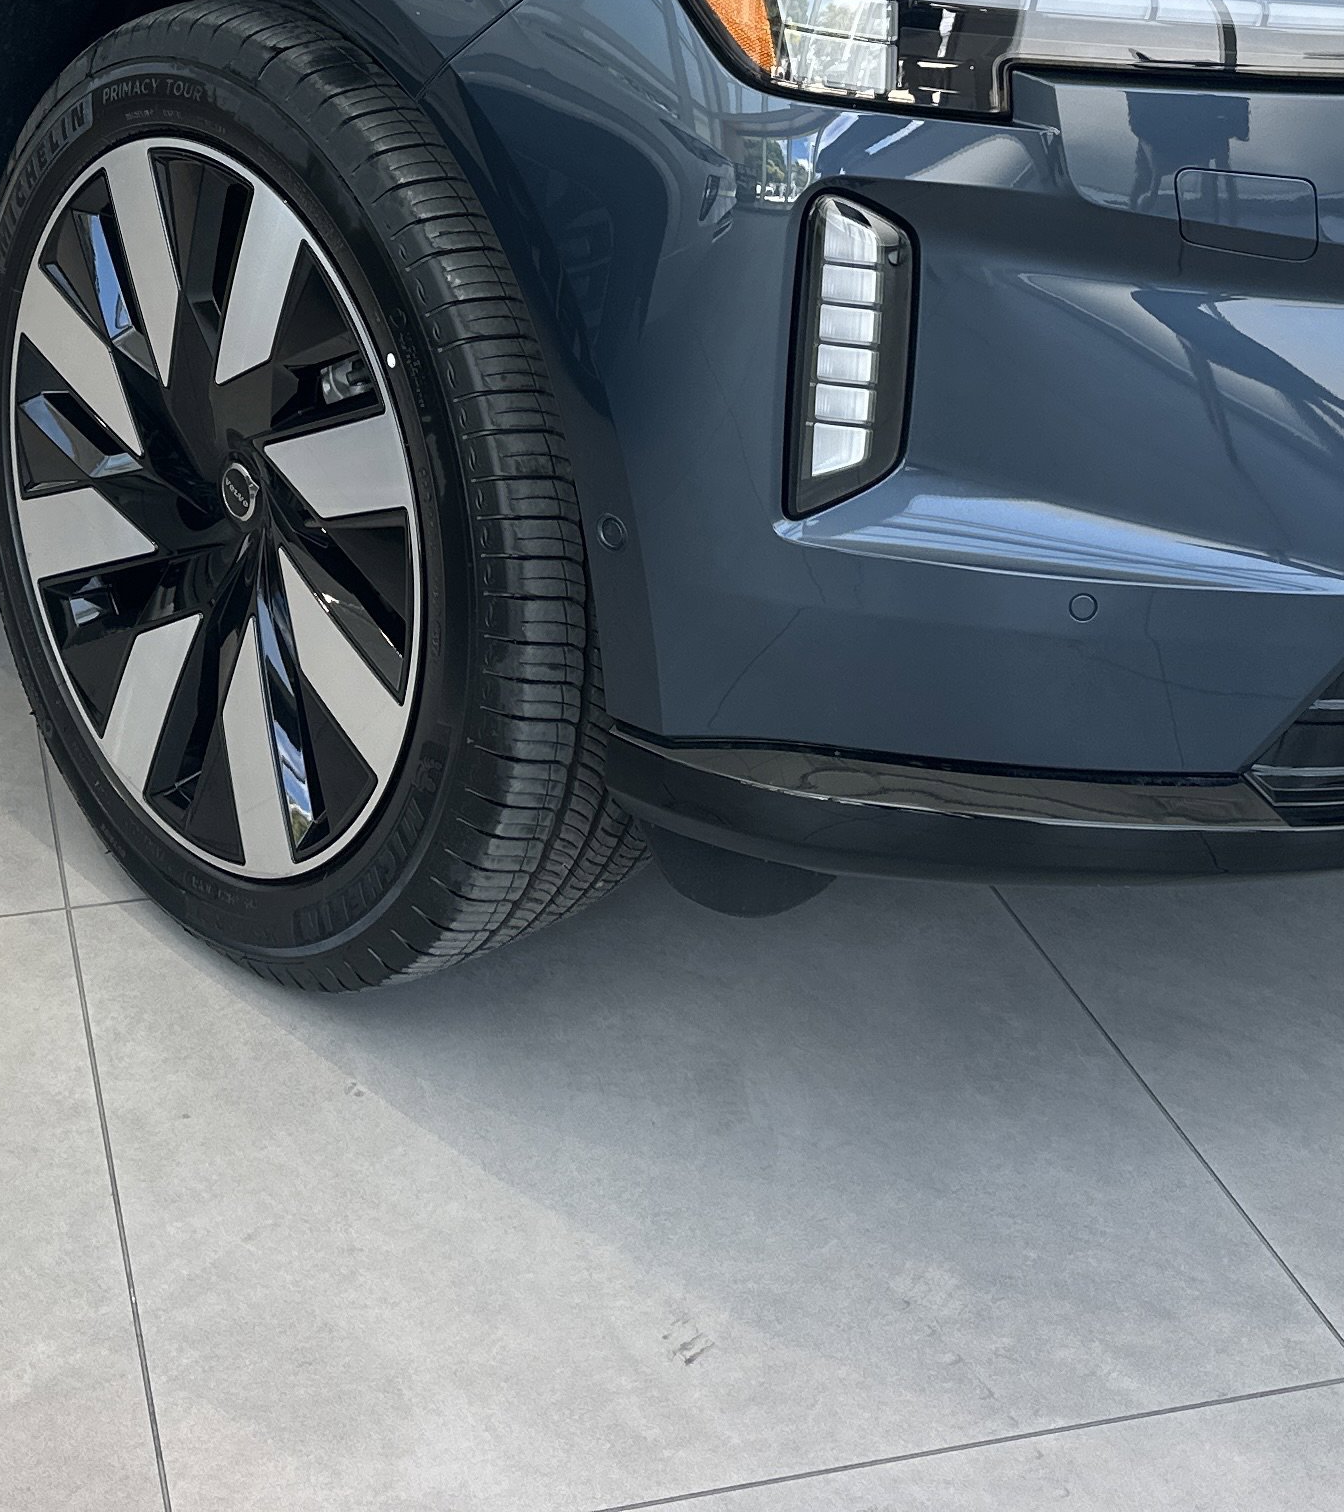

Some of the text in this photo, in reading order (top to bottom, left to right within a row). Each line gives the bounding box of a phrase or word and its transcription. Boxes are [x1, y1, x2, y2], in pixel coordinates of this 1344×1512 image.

[102, 77, 204, 105] PRIMACY TOUR
[225, 477, 249, 508] VOLVO
